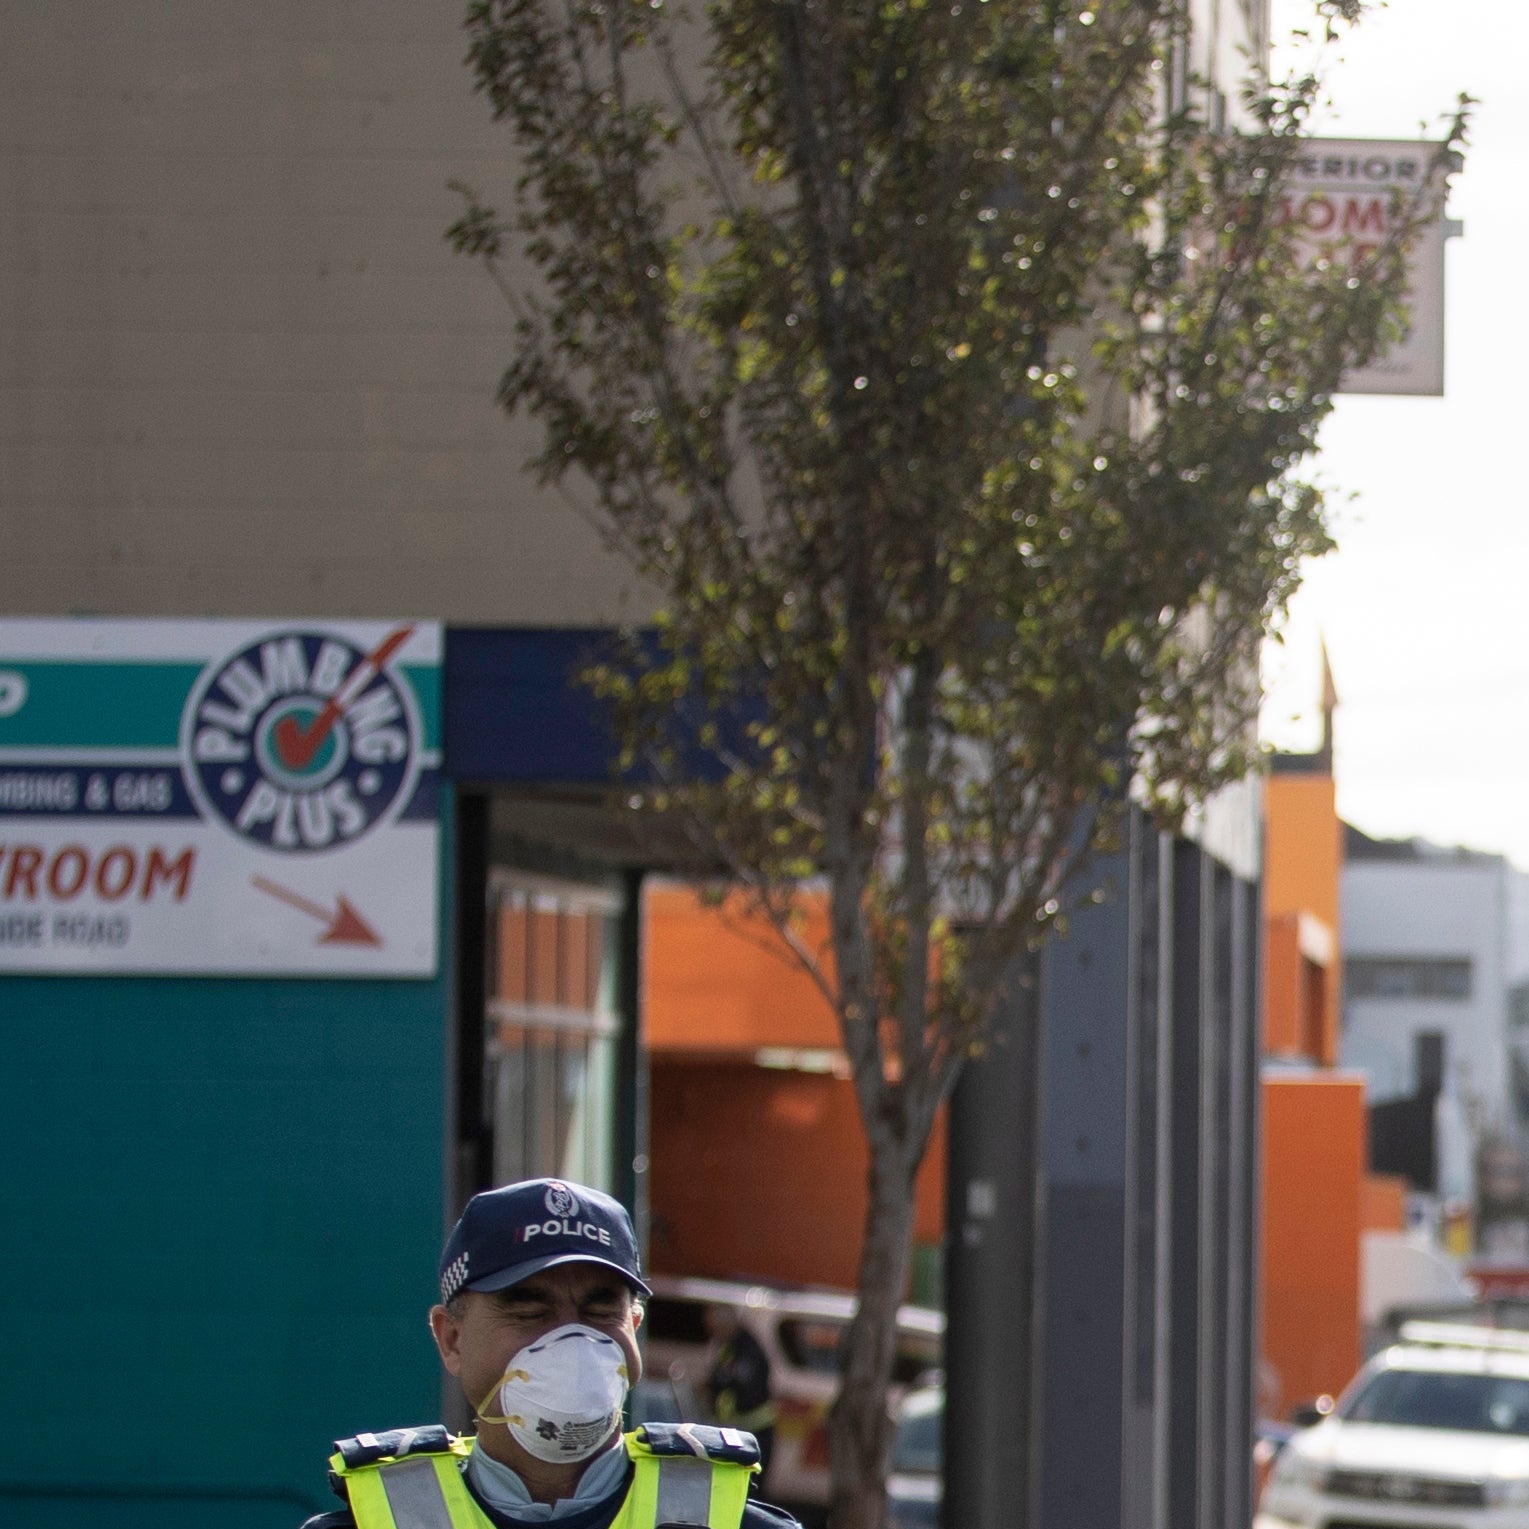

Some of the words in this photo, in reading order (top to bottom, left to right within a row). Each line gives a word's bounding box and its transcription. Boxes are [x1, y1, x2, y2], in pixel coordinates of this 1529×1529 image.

[196, 637, 408, 765] PLUMBING
[235, 778, 366, 846] PLUS
[0, 847, 195, 900] ROOM
[523, 1219, 611, 1247] POLICE
